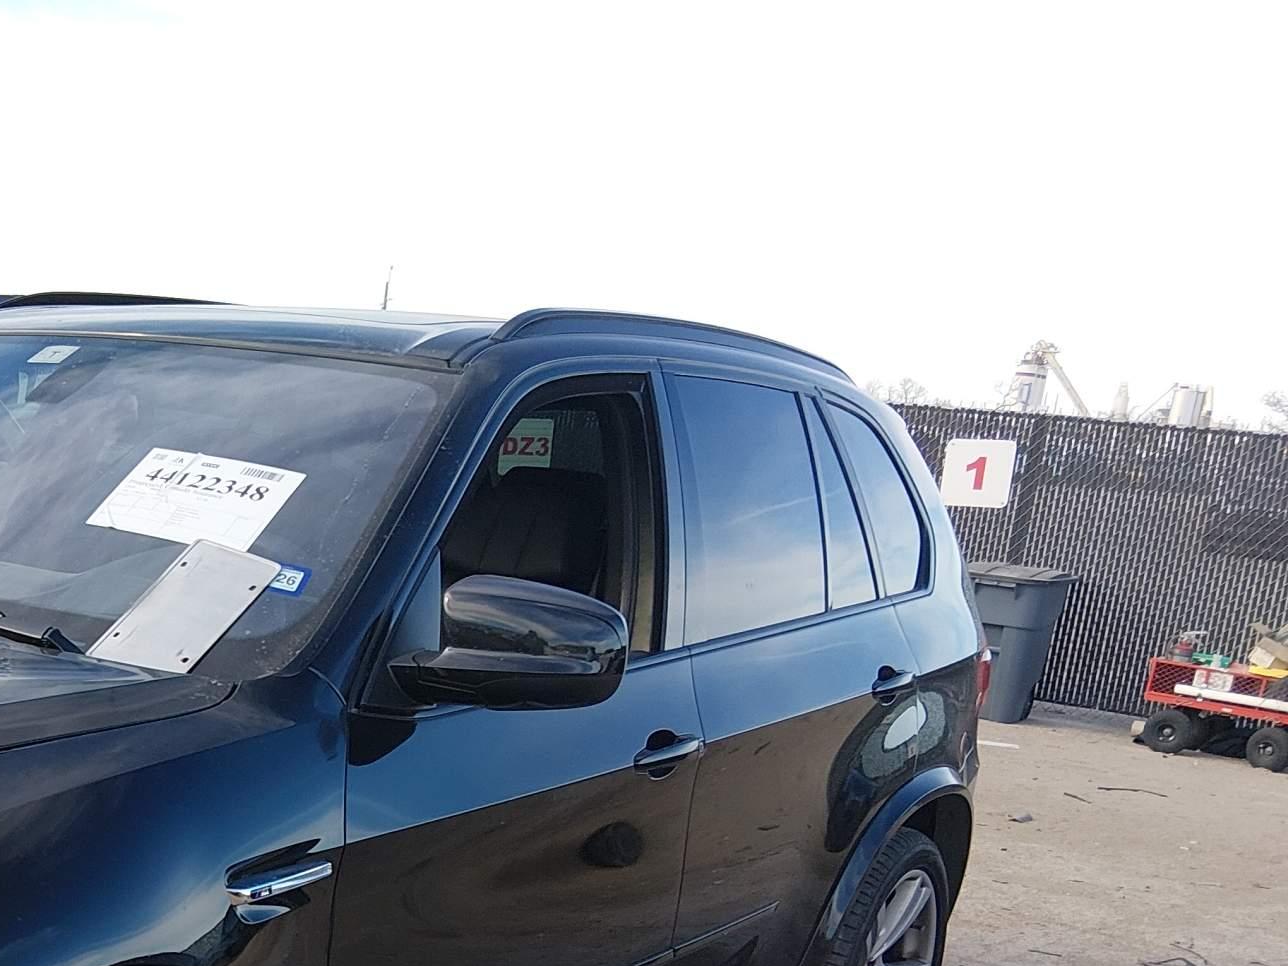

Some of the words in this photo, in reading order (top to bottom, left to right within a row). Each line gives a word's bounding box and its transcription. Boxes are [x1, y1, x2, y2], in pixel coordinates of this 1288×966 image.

[502, 436, 550, 456] DZ3
[146, 467, 270, 502] 44122348
[966, 456, 987, 490] 1
[276, 573, 297, 586] 26
